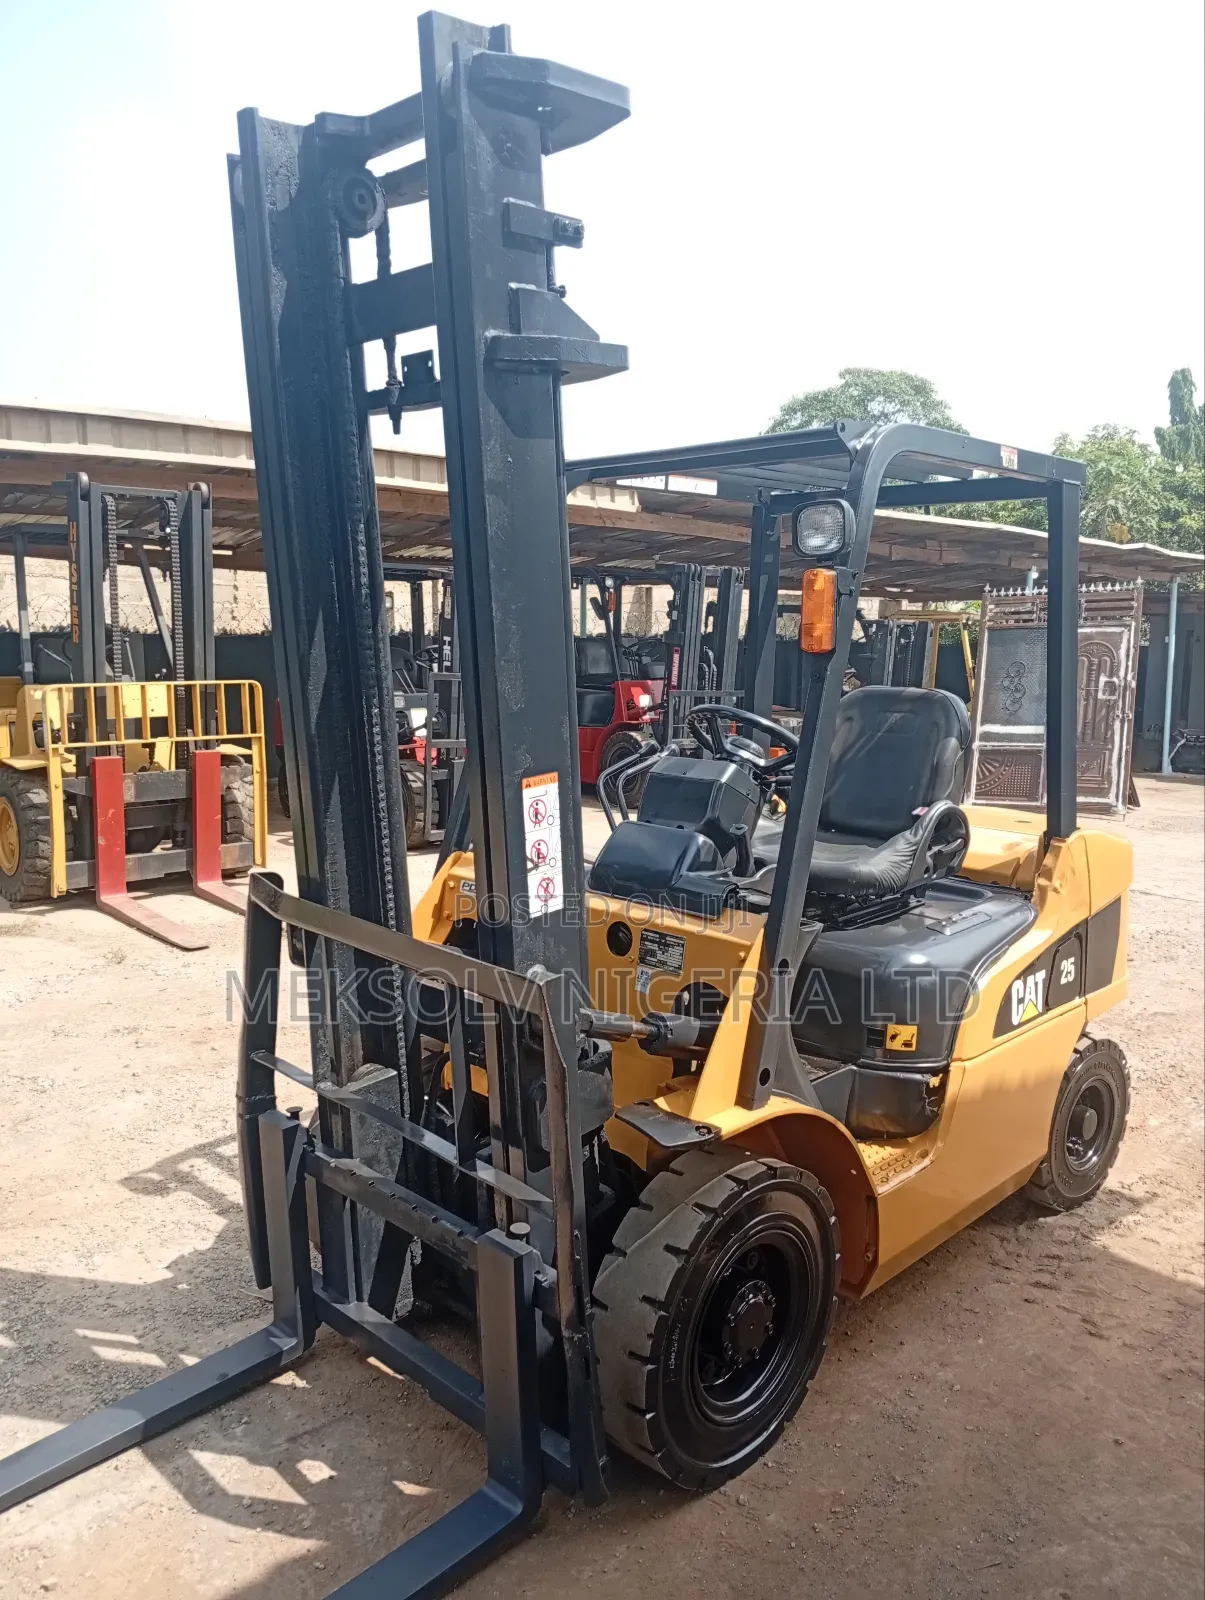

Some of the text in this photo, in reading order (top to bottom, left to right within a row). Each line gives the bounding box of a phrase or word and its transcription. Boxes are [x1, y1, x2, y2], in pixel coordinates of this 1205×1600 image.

[70, 521, 79, 643] HYSTER
[532, 775, 557, 787] WARNING
[1060, 956, 1075, 985] 25
[1011, 969, 1046, 1026] CAT
